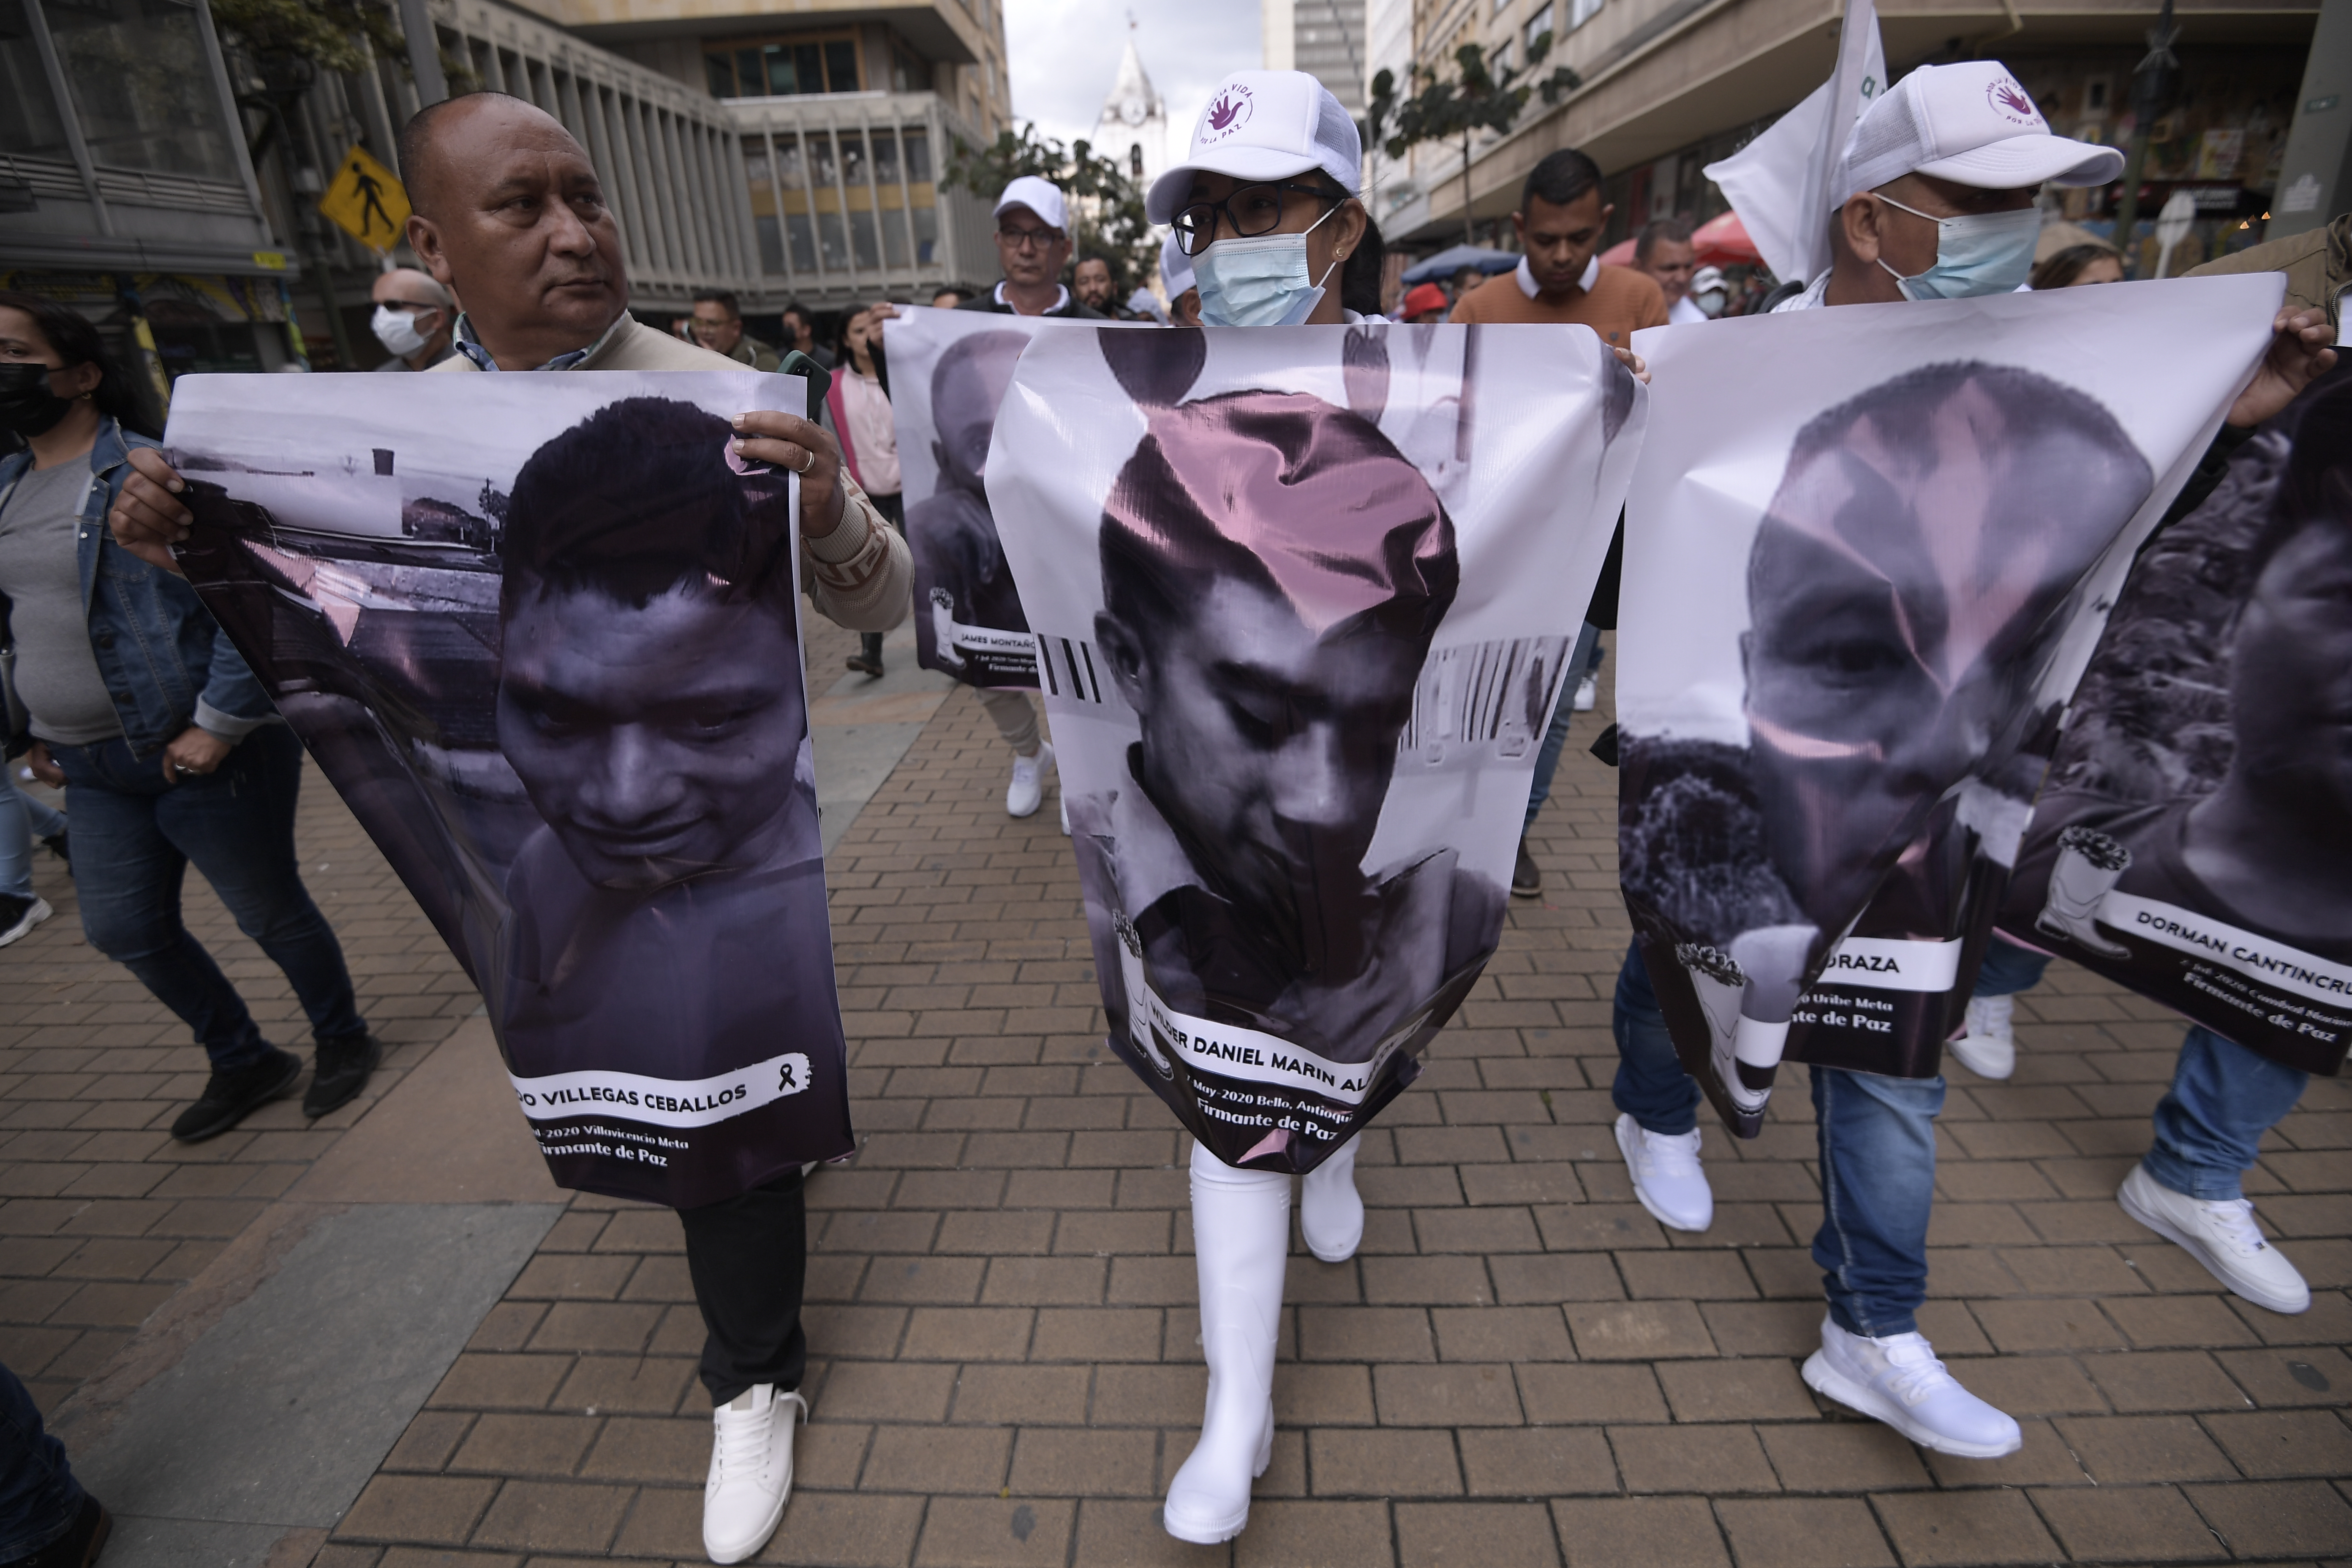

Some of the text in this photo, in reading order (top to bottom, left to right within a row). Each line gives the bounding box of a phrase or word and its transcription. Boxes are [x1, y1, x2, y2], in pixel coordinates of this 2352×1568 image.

[1220, 88, 1227, 96] LA
[1231, 84, 1253, 98] VIDA
[1222, 123, 1242, 139] PAZ
[961, 634, 988, 644] JAMES
[2137, 912, 2227, 953] DORMAN
[1813, 994, 1852, 1007] Uribe
[1855, 997, 1894, 1012] Meta
[2183, 972, 2337, 1042] Firmante de Paz
[1821, 1010, 1848, 1027] de
[1852, 1014, 1892, 1033] Paz
[1150, 1000, 1188, 1049] WILDER
[1193, 1036, 1265, 1066] DANIEL
[1271, 1052, 1335, 1087] MARIN
[541, 1086, 640, 1106] VILLEGAS
[645, 1083, 747, 1113] CEBALLOS
[1257, 1095, 1293, 1110] Bello,
[1197, 1097, 1338, 1140] Firmante de Paz
[583, 1125, 656, 1145] Villavicencio
[658, 1136, 689, 1150] Meta
[615, 1144, 635, 1160] de
[638, 1148, 669, 1168] Paz
